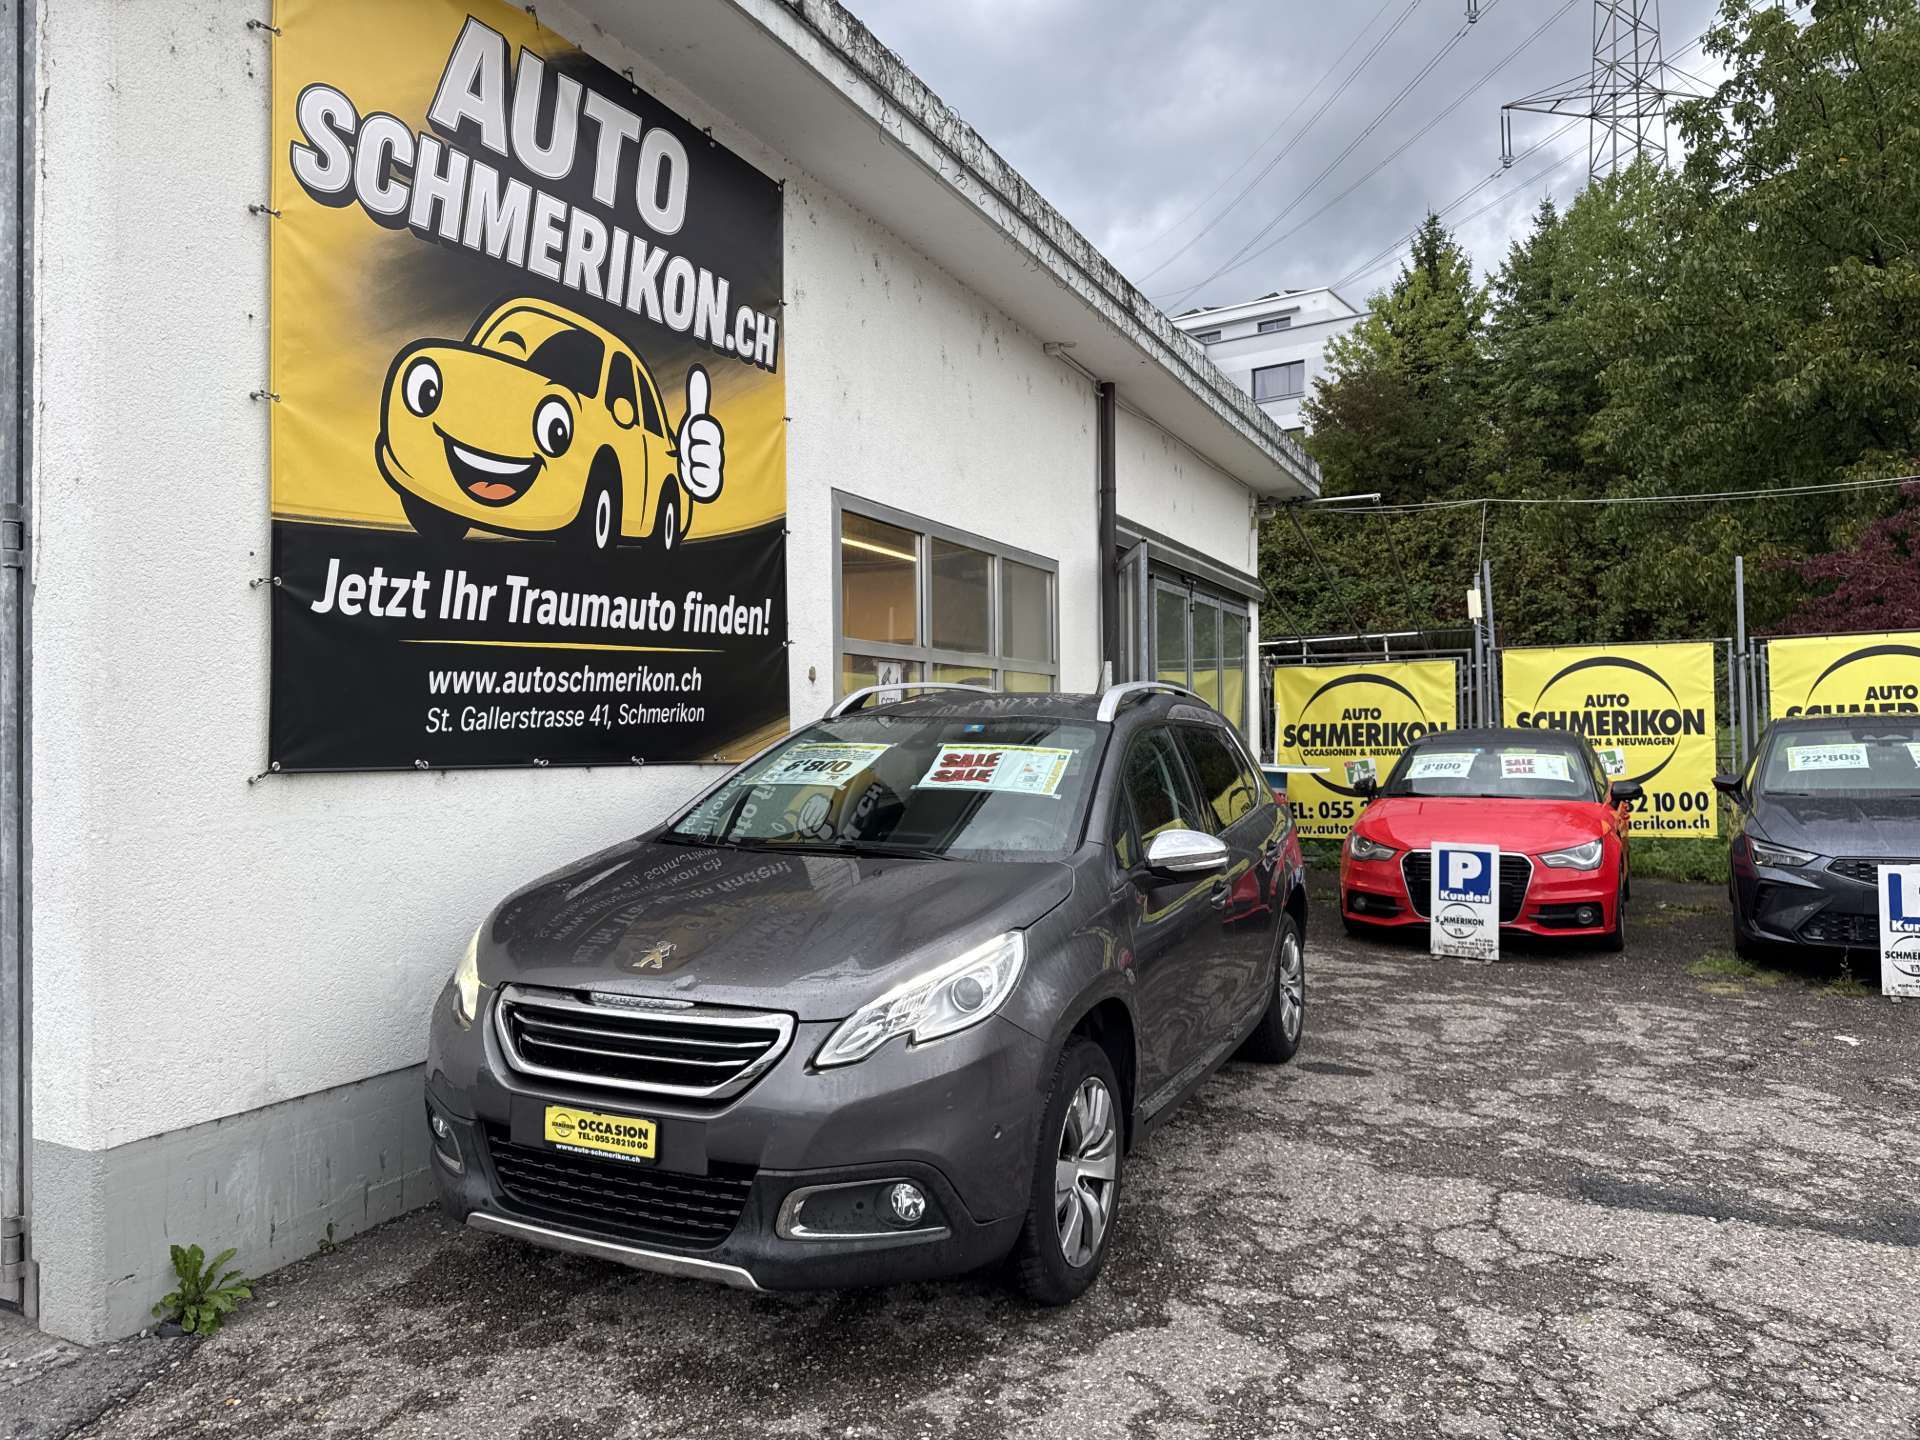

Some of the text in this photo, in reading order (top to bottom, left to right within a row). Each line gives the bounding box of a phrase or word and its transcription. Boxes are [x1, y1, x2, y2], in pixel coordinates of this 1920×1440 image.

[428, 15, 691, 236] AUTO
[291, 83, 778, 373] SCHMERIKON.CH
[310, 557, 772, 635] Jetzt Ihr Traumauto finden!
[428, 664, 702, 695] www.autoschmerikon.ch
[1865, 685, 1919, 700] AUTO
[1584, 694, 1630, 708] AUTO
[425, 702, 705, 733] St. Gallerstrasse 41, Schmerikon
[1341, 707, 1382, 721] AUTO
[1516, 708, 1706, 738] SCHMERIKON
[1605, 737, 1613, 746] &
[1616, 737, 1675, 746] NEUWAGEN
[939, 752, 1003, 768] SALE
[1302, 748, 1408, 757] OCCASIONEN & NEUWA
[1505, 758, 1535, 767] SALE
[930, 768, 995, 783] SALE
[1506, 767, 1537, 775] SALE
[1653, 793, 1675, 812] 10
[1679, 792, 1709, 811] 00
[1289, 801, 1355, 819] EL: 055
[1448, 852, 1482, 889] P
[1440, 889, 1490, 904] Kunden
[1434, 915, 1485, 926] SHMERIKON
[1884, 950, 1920, 960] SCHME
[577, 1118, 649, 1140] OCCASION
[577, 1131, 594, 1142] TEL:
[555, 1143, 640, 1164] www.auto-schmerikon.ch
